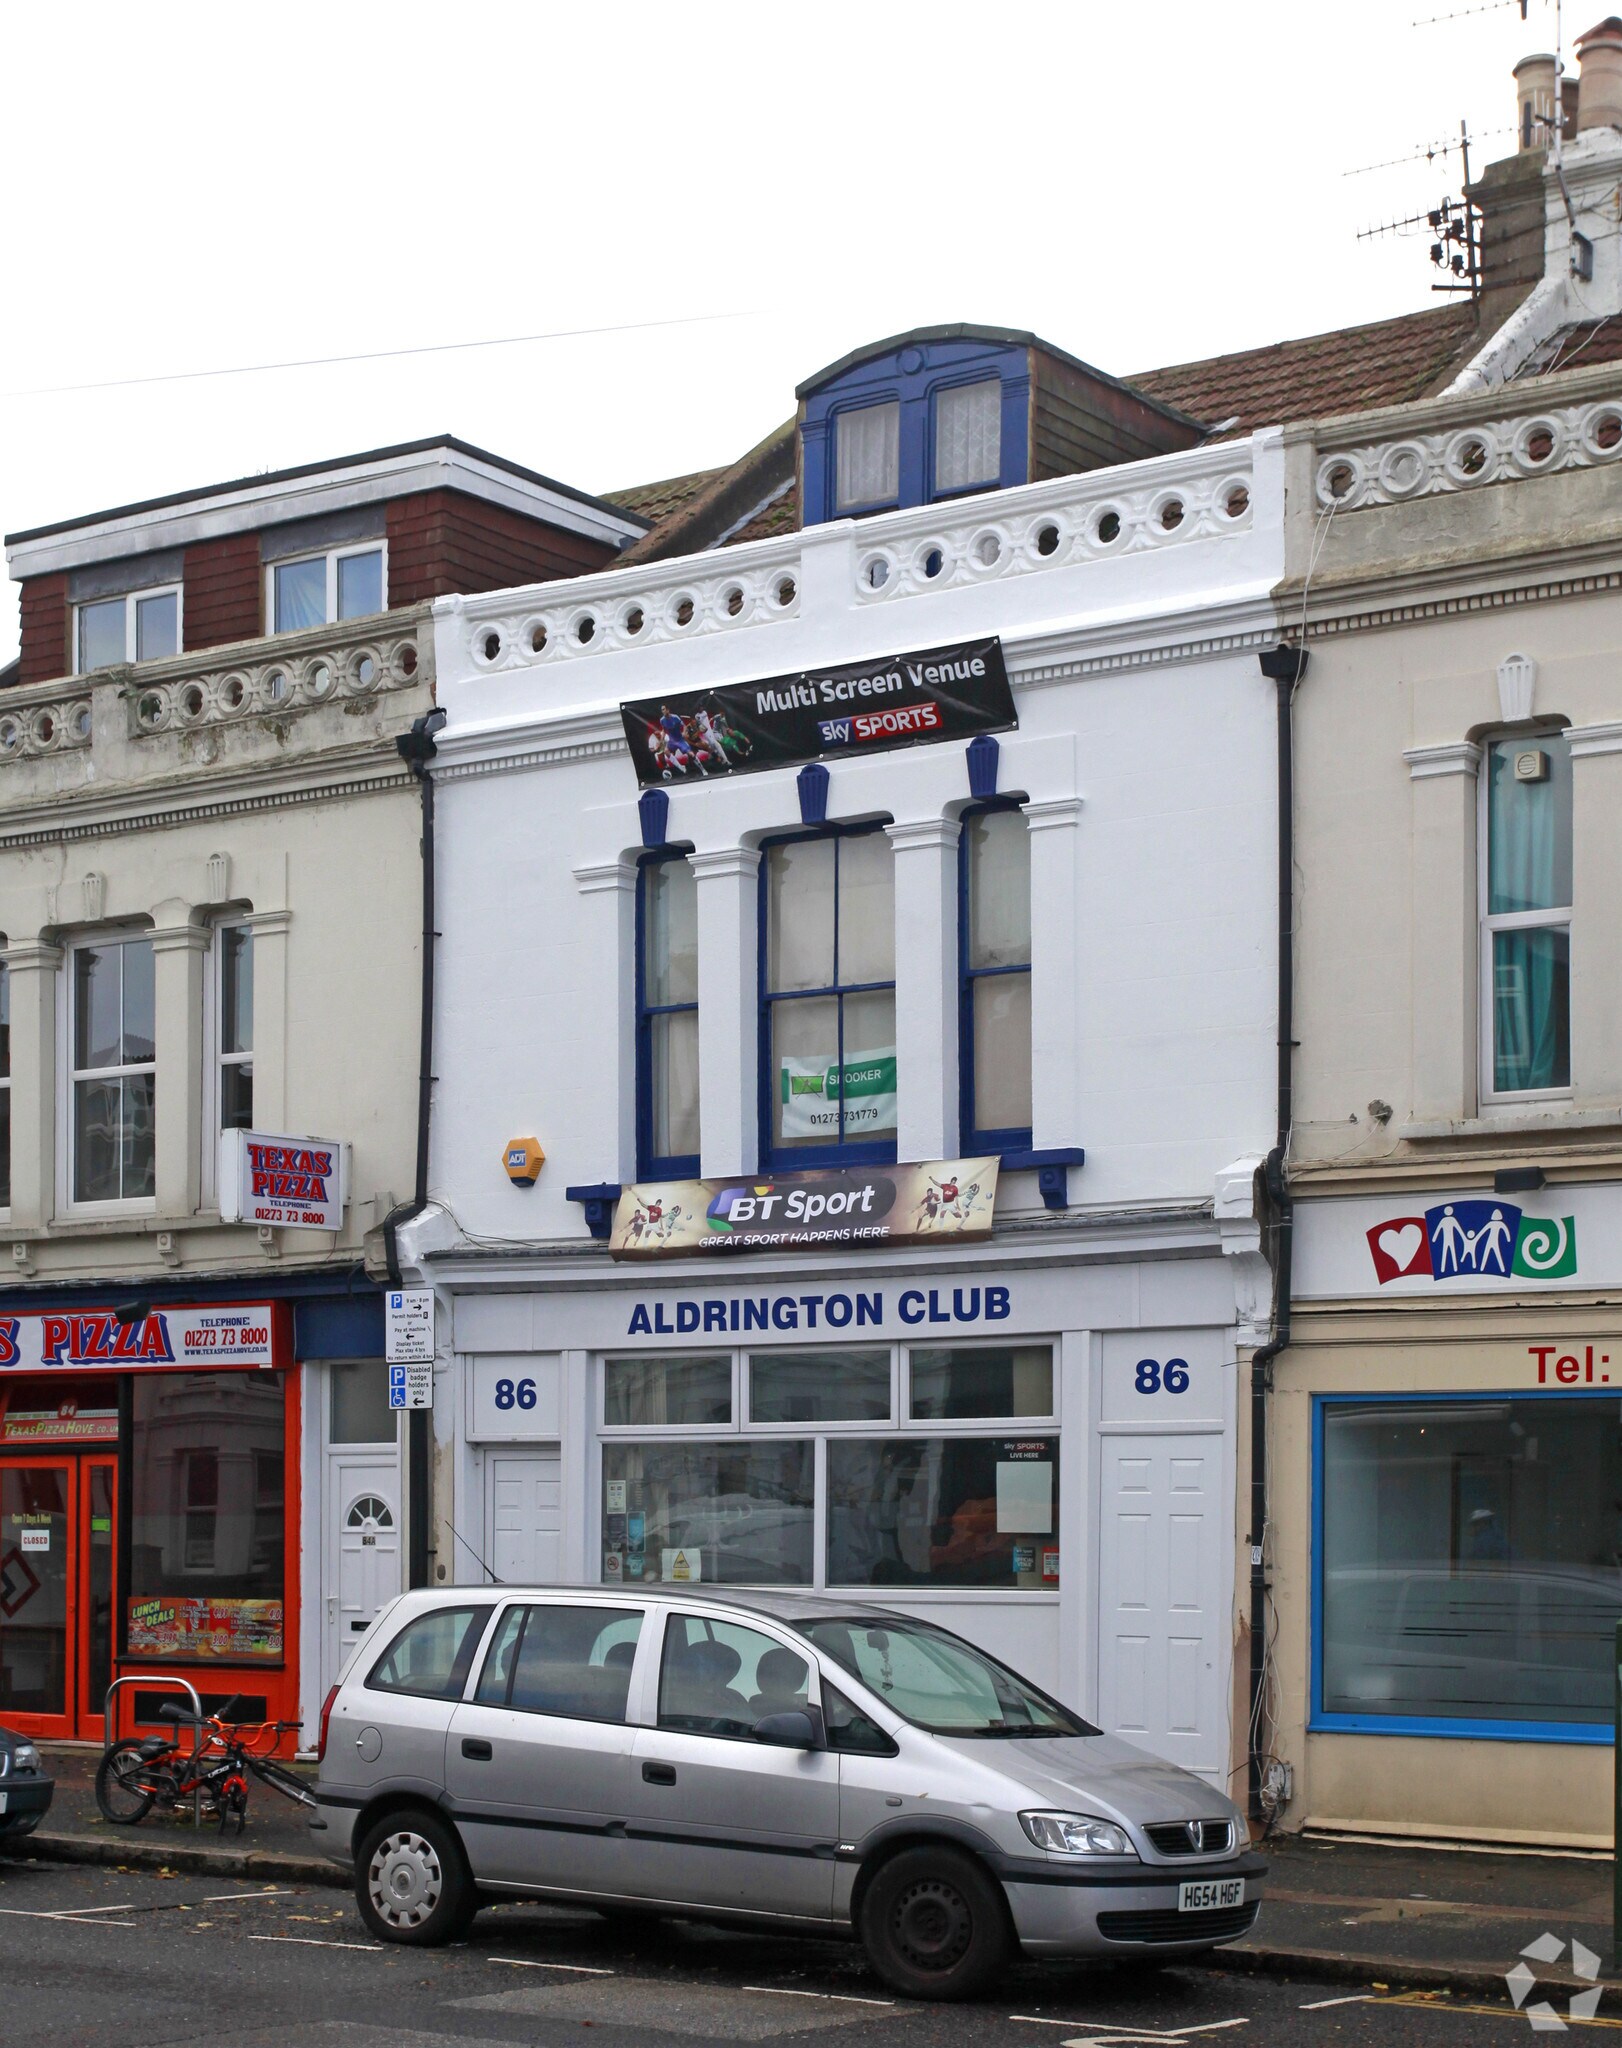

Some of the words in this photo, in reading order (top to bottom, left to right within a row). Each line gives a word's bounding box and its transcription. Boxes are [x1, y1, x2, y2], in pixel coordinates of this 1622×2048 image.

[757, 681, 818, 715] Multi
[820, 671, 903, 704] Screen
[907, 656, 986, 688] Venue
[821, 722, 850, 745] sky
[855, 705, 938, 738] SPORTS
[828, 1068, 882, 1085] SOOKER
[810, 1112, 840, 1125] 01273
[844, 1108, 878, 1122] 731779
[247, 1143, 332, 1177] TEXAS
[508, 1153, 526, 1164] ADT
[251, 1169, 329, 1203] PIZZA
[255, 1207, 282, 1221] 01273
[286, 1210, 298, 1223] 73
[302, 1212, 325, 1225] 8000
[728, 1195, 783, 1223] BT
[784, 1185, 876, 1224] Sport
[698, 1235, 742, 1248] GREAT
[743, 1233, 789, 1246] SPORT
[789, 1228, 851, 1243] HAPPENS
[853, 1226, 890, 1239] HERE
[627, 1292, 883, 1335] ALDRINGTON
[898, 1286, 1012, 1323] CLUB
[41, 1313, 176, 1365] PIZZA
[184, 1330, 217, 1347] 01273
[221, 1329, 236, 1346] 73
[240, 1327, 268, 1345] 8000
[1134, 1357, 1190, 1395] 86
[1528, 1345, 1610, 1384] Tel:
[494, 1378, 537, 1411] 86
[60, 1405, 76, 1416] 84
[1016, 1442, 1045, 1450] SPORTS
[23, 1536, 48, 1545] CLOSED
[132, 1600, 161, 1619] LUNCH
[145, 1607, 175, 1628] DEALS
[1184, 1884, 1218, 1908] HG54
[1220, 1882, 1241, 1905] HGF
